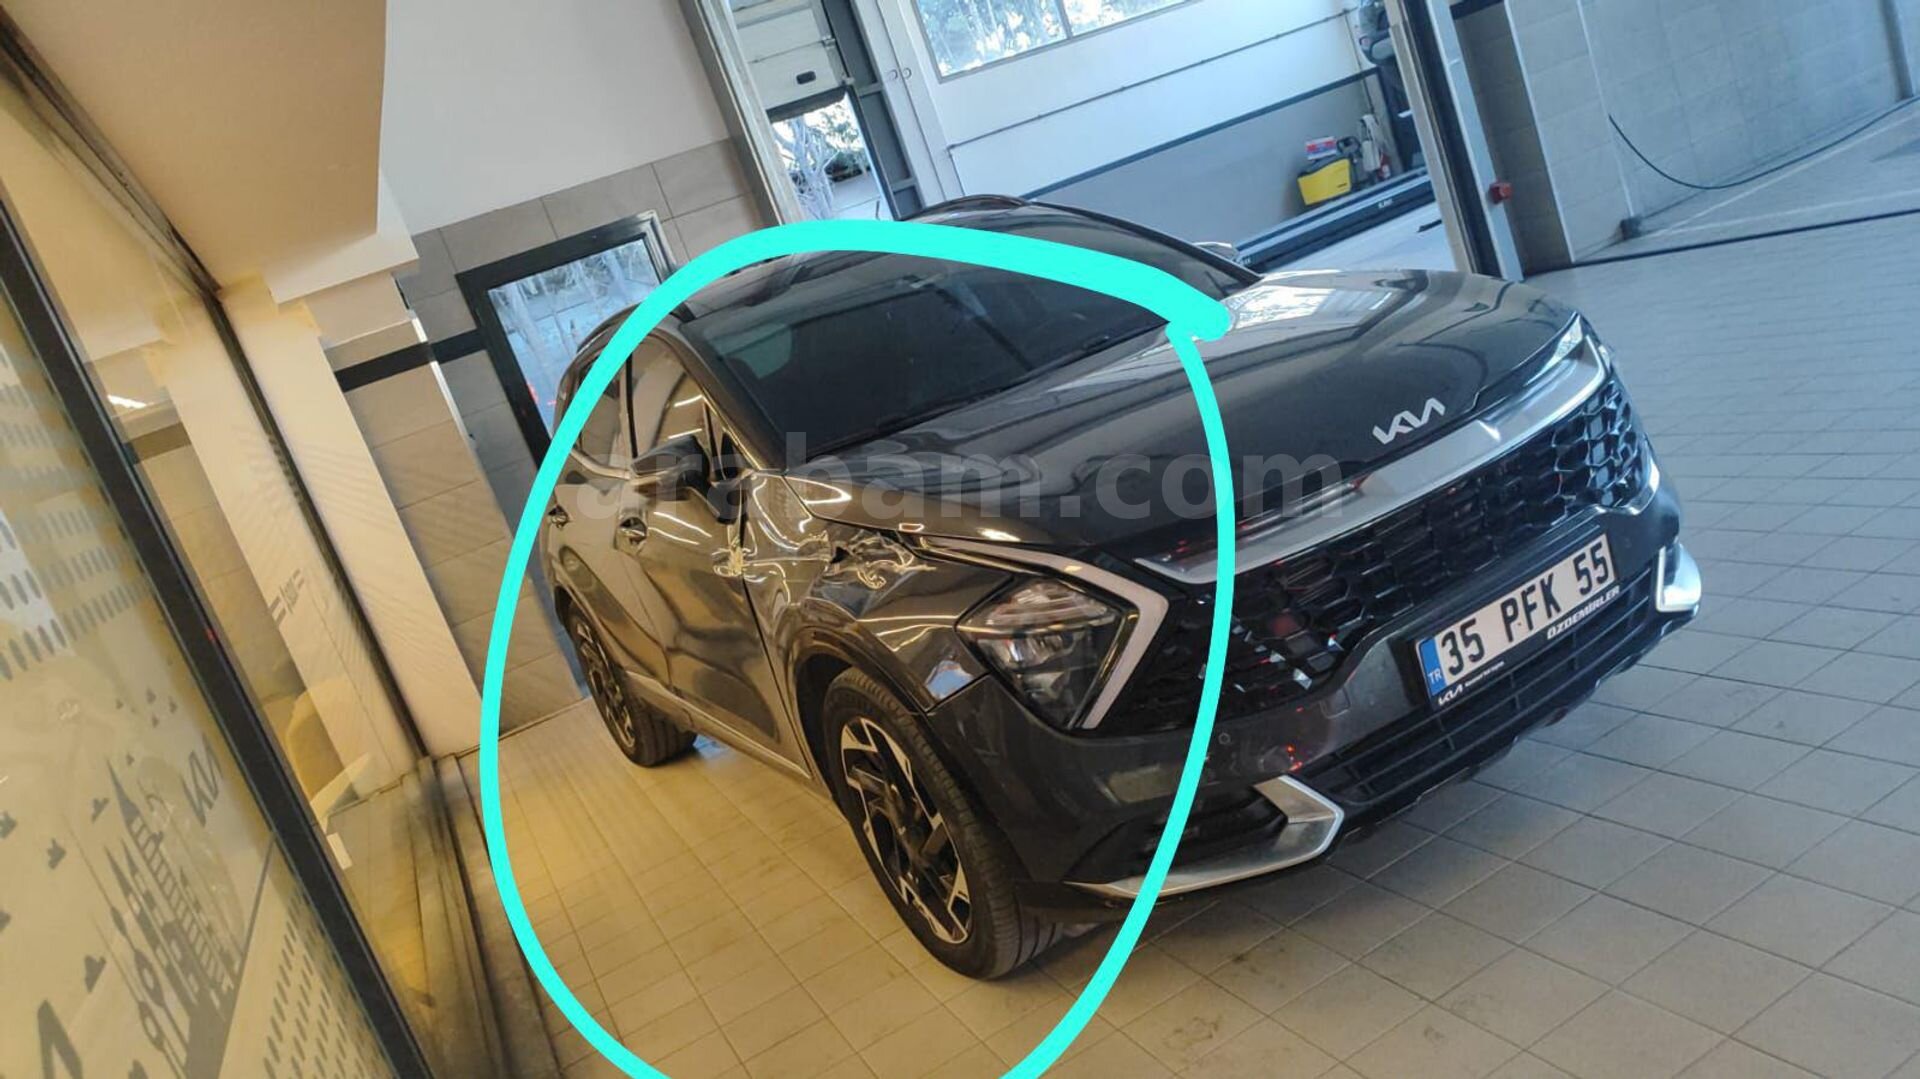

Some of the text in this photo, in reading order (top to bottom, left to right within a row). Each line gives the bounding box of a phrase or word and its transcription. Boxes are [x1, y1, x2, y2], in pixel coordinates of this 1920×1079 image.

[1372, 397, 1445, 445] KIA
[1441, 617, 1485, 676] 35
[1500, 572, 1562, 643] PFK
[1573, 541, 1609, 596] 55
[1427, 667, 1443, 685] TR
